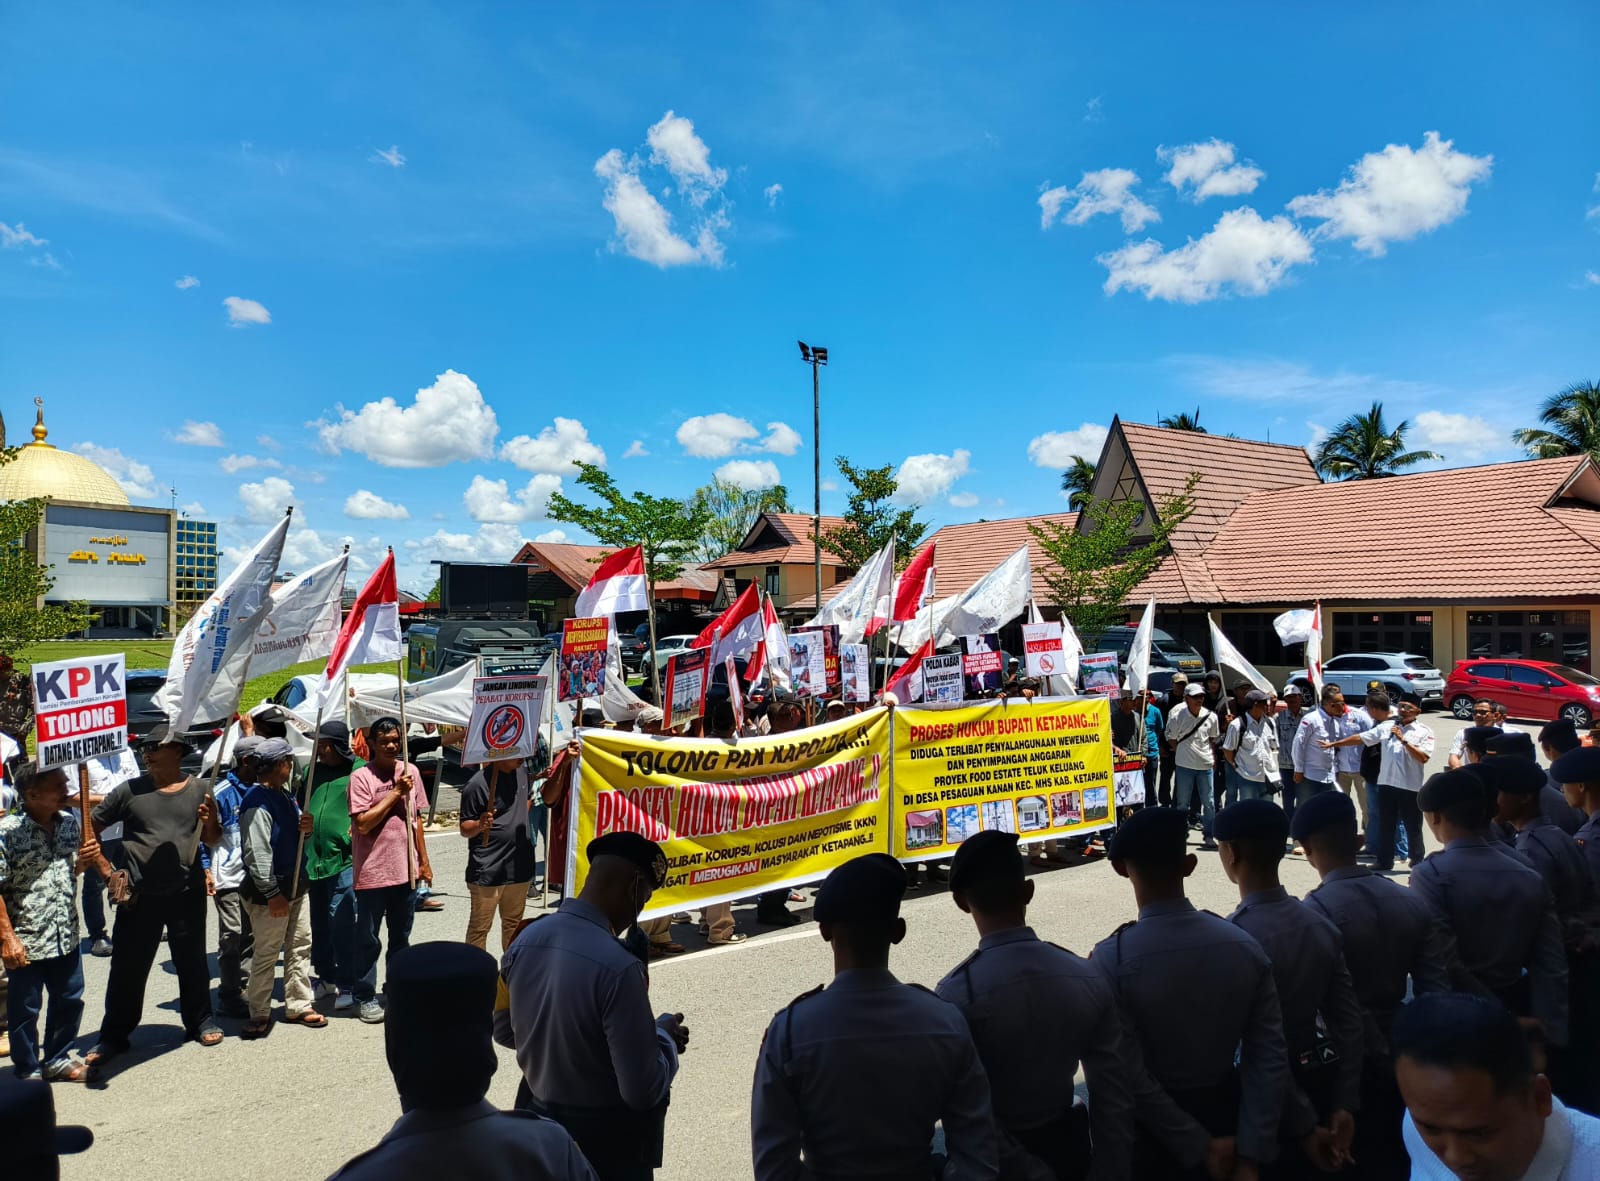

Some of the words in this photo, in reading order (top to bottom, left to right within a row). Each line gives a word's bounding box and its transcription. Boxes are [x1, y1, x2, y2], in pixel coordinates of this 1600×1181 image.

[573, 619, 603, 629] KORUPSI
[926, 658, 943, 670] POLDA
[36, 662, 121, 704] KPK
[482, 682, 508, 691] JANGAN
[508, 681, 538, 690] LINDUNGI
[45, 706, 115, 737] TOLONG
[910, 723, 954, 742] PROSES
[956, 719, 995, 738] HUKUM
[997, 717, 1033, 735] BUPATI
[44, 741, 72, 765] DATANG
[72, 739, 81, 759] KE
[911, 746, 944, 760] DIDUGA
[946, 743, 983, 757] TERLIBAT
[985, 737, 1056, 753] PENYALAHGUNAAN
[1058, 733, 1100, 746] WEWENANG
[947, 760, 964, 771] DAN
[966, 754, 1028, 769] PENYIMPANGAN
[1030, 749, 1071, 761] ANGGARAN
[621, 750, 720, 776] TOLONG
[724, 748, 766, 769] PAK
[934, 774, 968, 787] PROYEK
[970, 771, 991, 785] FOOD
[994, 767, 1022, 780] ESTATE
[1023, 764, 1048, 777] TELUK
[1050, 760, 1085, 772] KELUANG
[904, 794, 913, 806] DI
[916, 792, 939, 804] DESA
[941, 786, 985, 800] PESAGUAN
[987, 782, 1014, 795] KANAN
[1015, 780, 1034, 791] KEC.
[1035, 777, 1053, 788] MHS
[1054, 775, 1072, 786] KAB.
[1074, 770, 1108, 784] KETAPANG
[595, 785, 675, 843] PROSES
[674, 778, 742, 839] HUKUM
[742, 772, 799, 829] BUPATI
[705, 845, 752, 862] KORUPSI,
[754, 839, 786, 854] KOLUSI
[787, 831, 807, 847] DAN
[807, 821, 852, 840] NEPOTISME
[854, 815, 877, 830] (KKN)
[693, 860, 758, 883] MERUGIKAN
[761, 845, 819, 870] MASYARAKAT
